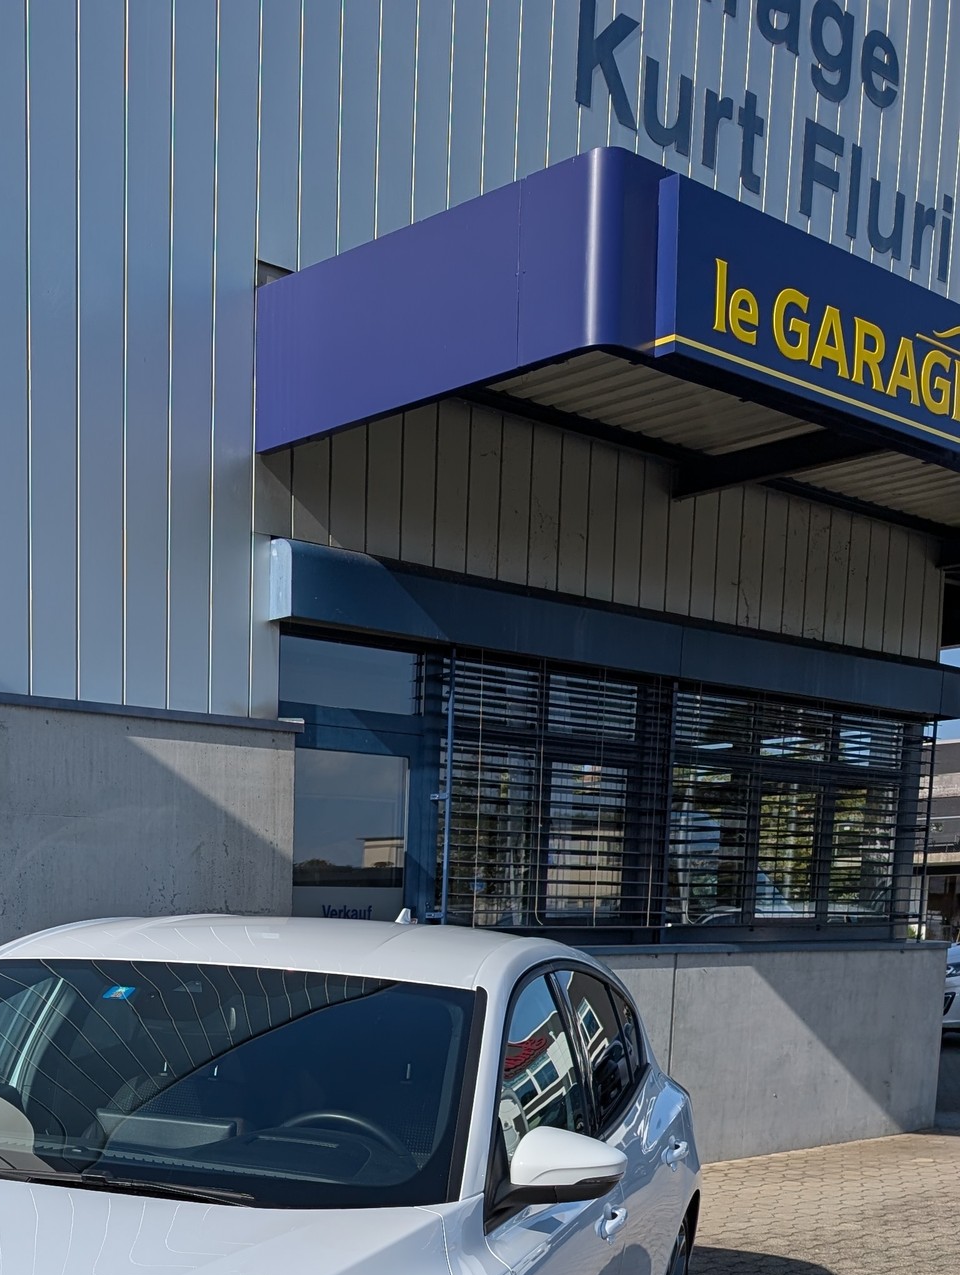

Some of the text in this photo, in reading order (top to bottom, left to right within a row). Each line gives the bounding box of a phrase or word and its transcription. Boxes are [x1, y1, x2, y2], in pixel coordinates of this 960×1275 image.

[575, 0, 953, 282] Kurt Fluri
[713, 258, 759, 346] le
[322, 904, 373, 920] Verkauf
